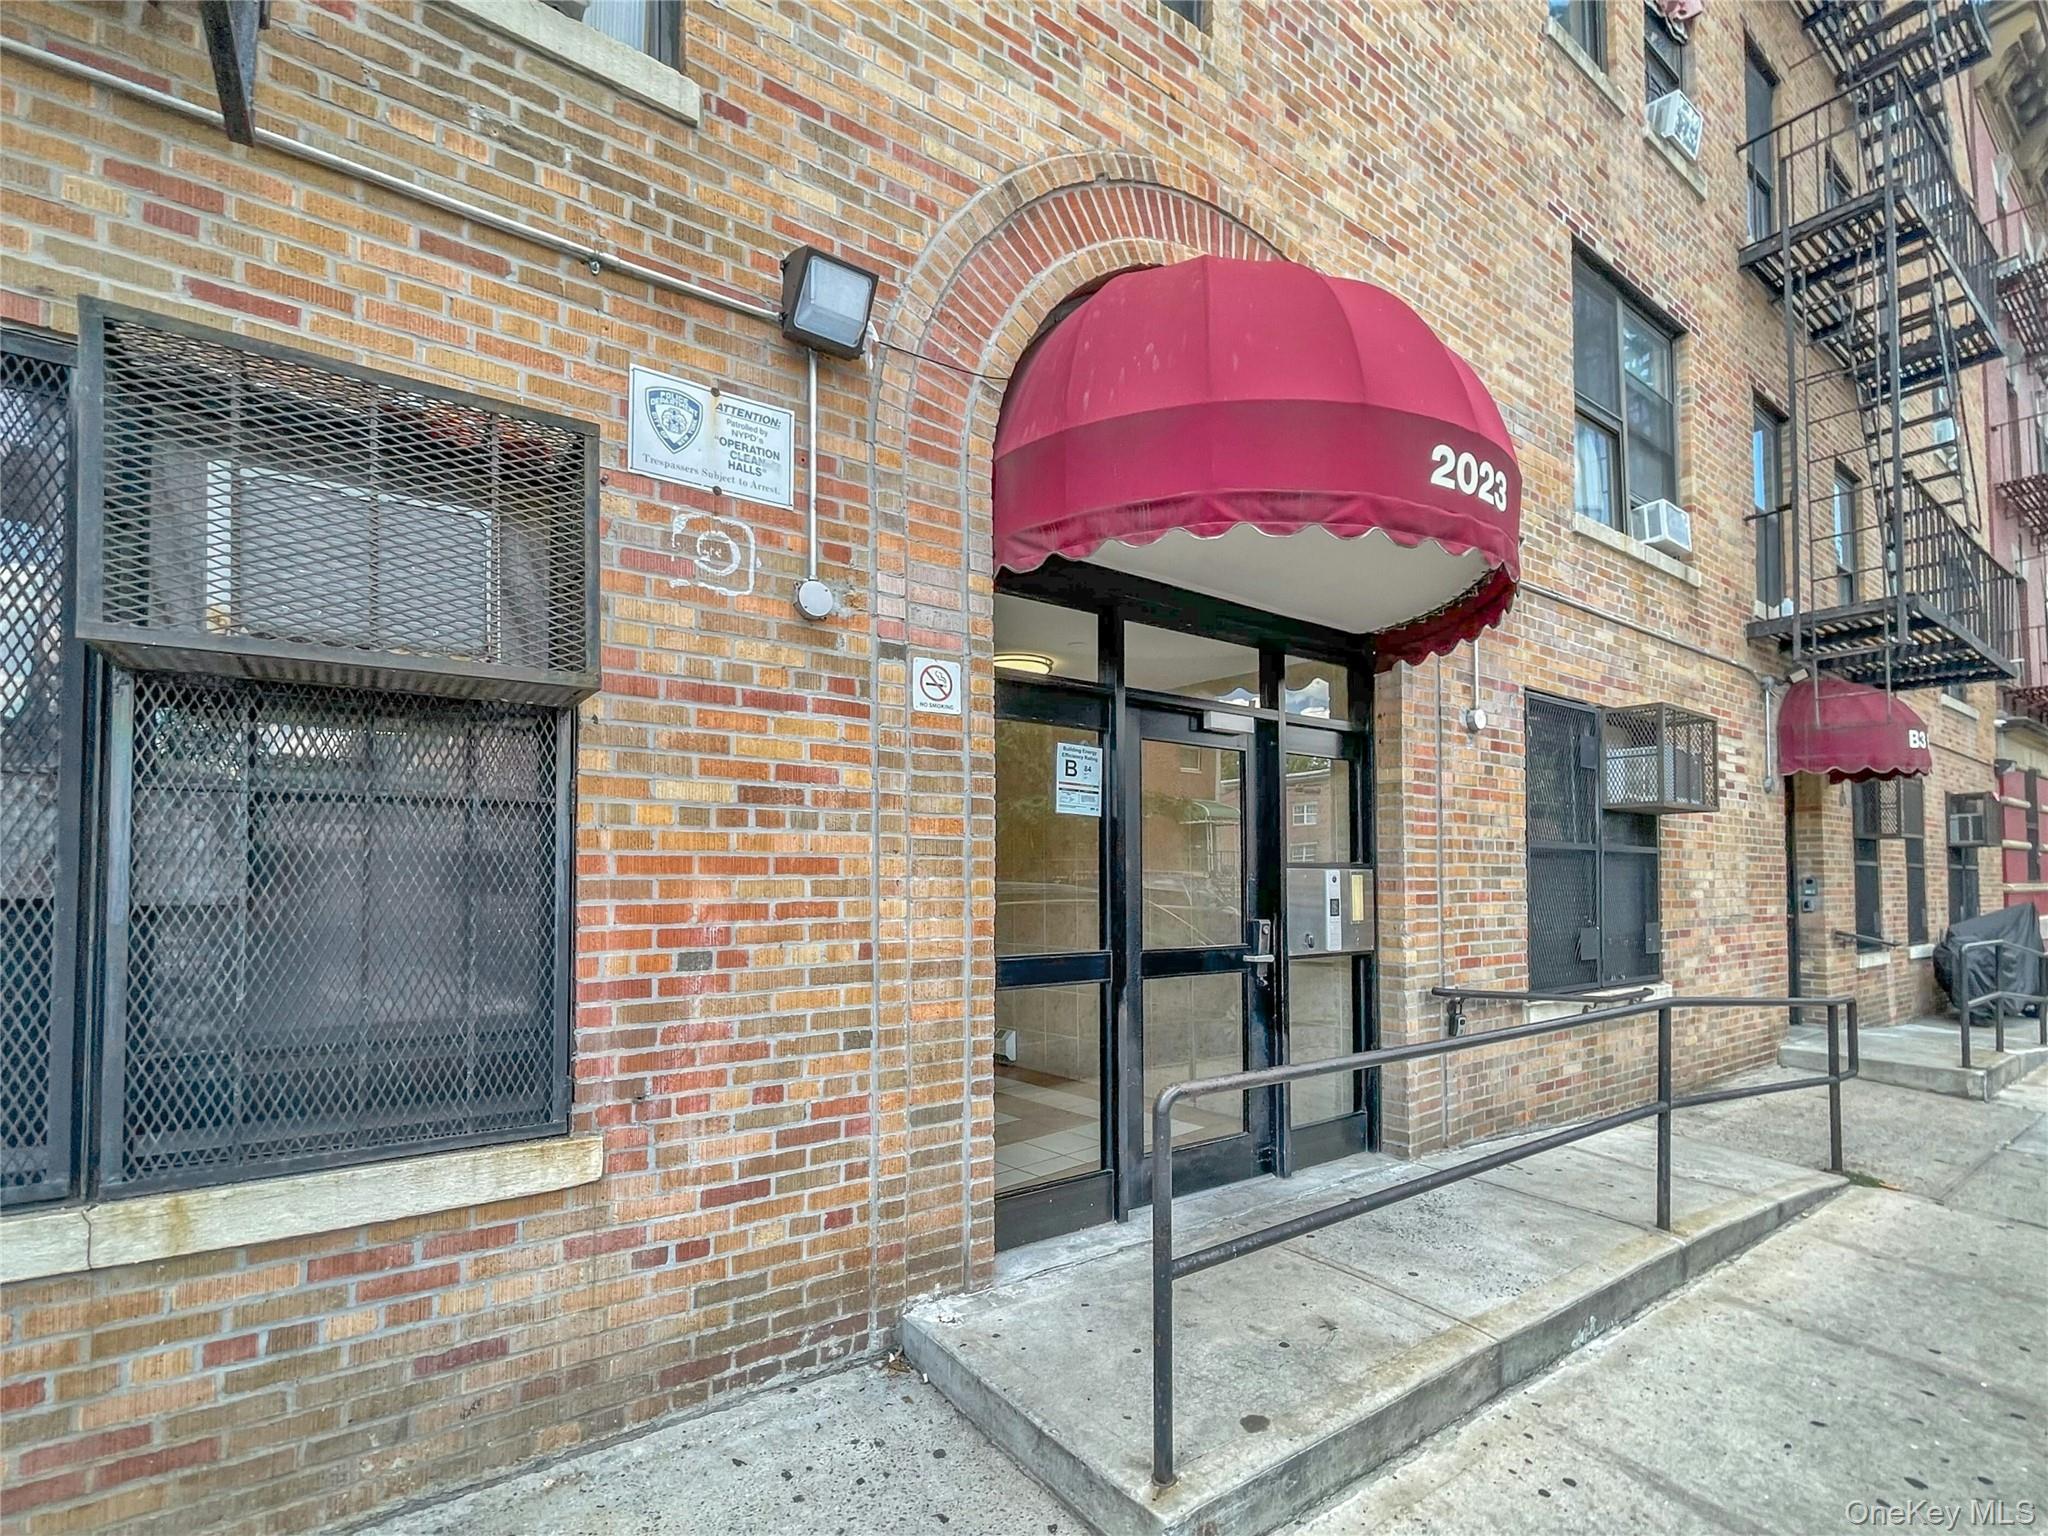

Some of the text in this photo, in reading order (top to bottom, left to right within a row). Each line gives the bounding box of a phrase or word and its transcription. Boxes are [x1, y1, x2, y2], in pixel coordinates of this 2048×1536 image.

[660, 391, 689, 406] POLICE
[715, 402, 782, 428] ATTENTION:
[726, 418, 768, 438] Patrolled by
[729, 449, 766, 467] CLEAN
[642, 452, 699, 475] Trespassers
[702, 467, 735, 485] Subject
[739, 478, 748, 487] to
[1430, 444, 1507, 512] 2023
[1065, 760, 1077, 776] B
